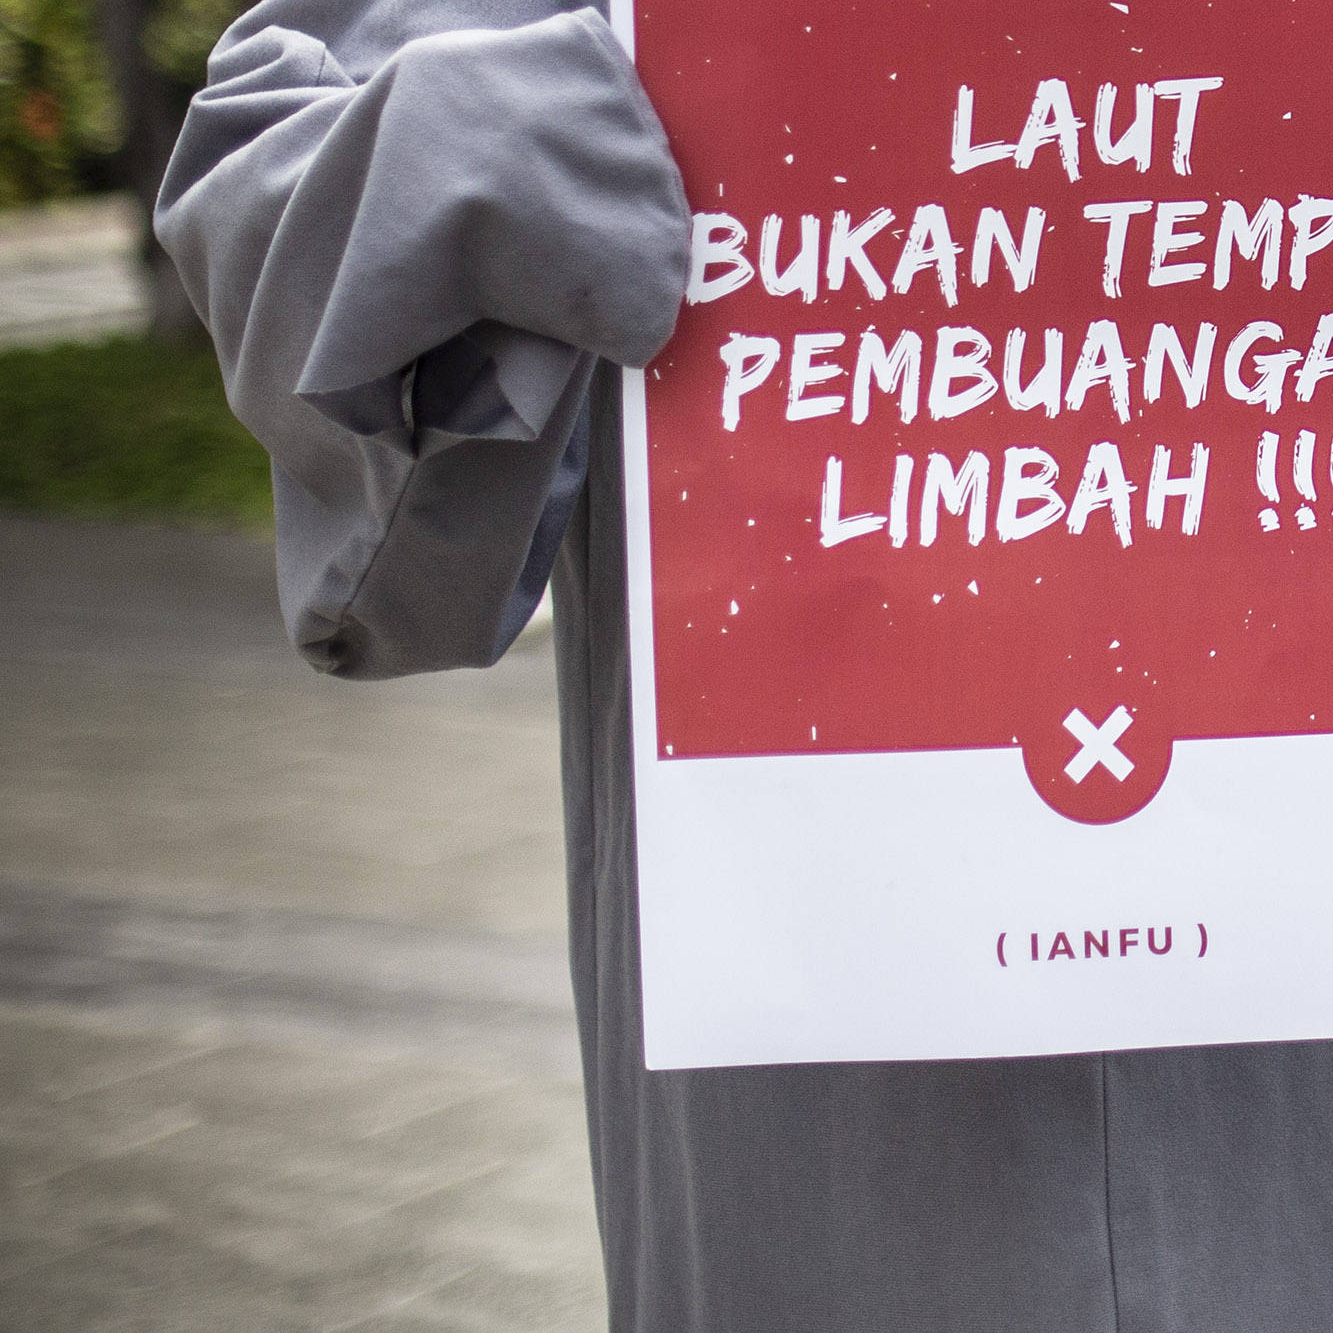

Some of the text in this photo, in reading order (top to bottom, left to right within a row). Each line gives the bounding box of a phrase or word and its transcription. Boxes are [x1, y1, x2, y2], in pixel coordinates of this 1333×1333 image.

[951, 77, 1223, 183] LAUT
[687, 204, 1046, 307] BUKAN
[820, 442, 1209, 548] LIMBAH
